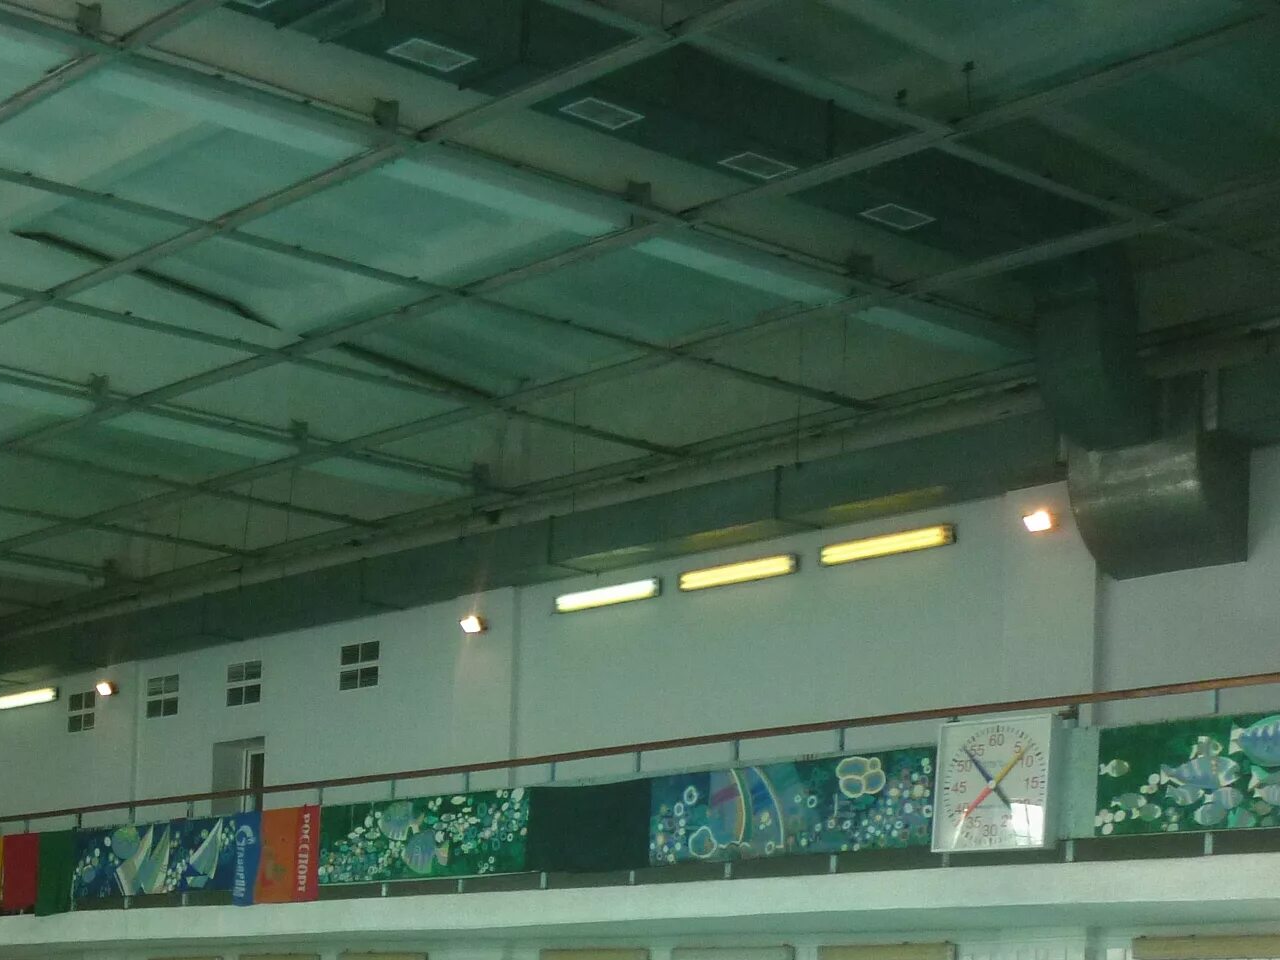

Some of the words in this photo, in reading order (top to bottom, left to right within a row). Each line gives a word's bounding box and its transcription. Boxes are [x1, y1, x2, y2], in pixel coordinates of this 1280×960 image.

[989, 733, 1005, 746] 60
[970, 744, 985, 757] 55
[1014, 741, 1022, 754] 5
[956, 759, 972, 772] 50
[1020, 755, 1034, 768] 10
[951, 781, 967, 794] 45
[1024, 776, 1039, 789] 15
[966, 816, 981, 829] 35
[982, 824, 998, 837] 30
